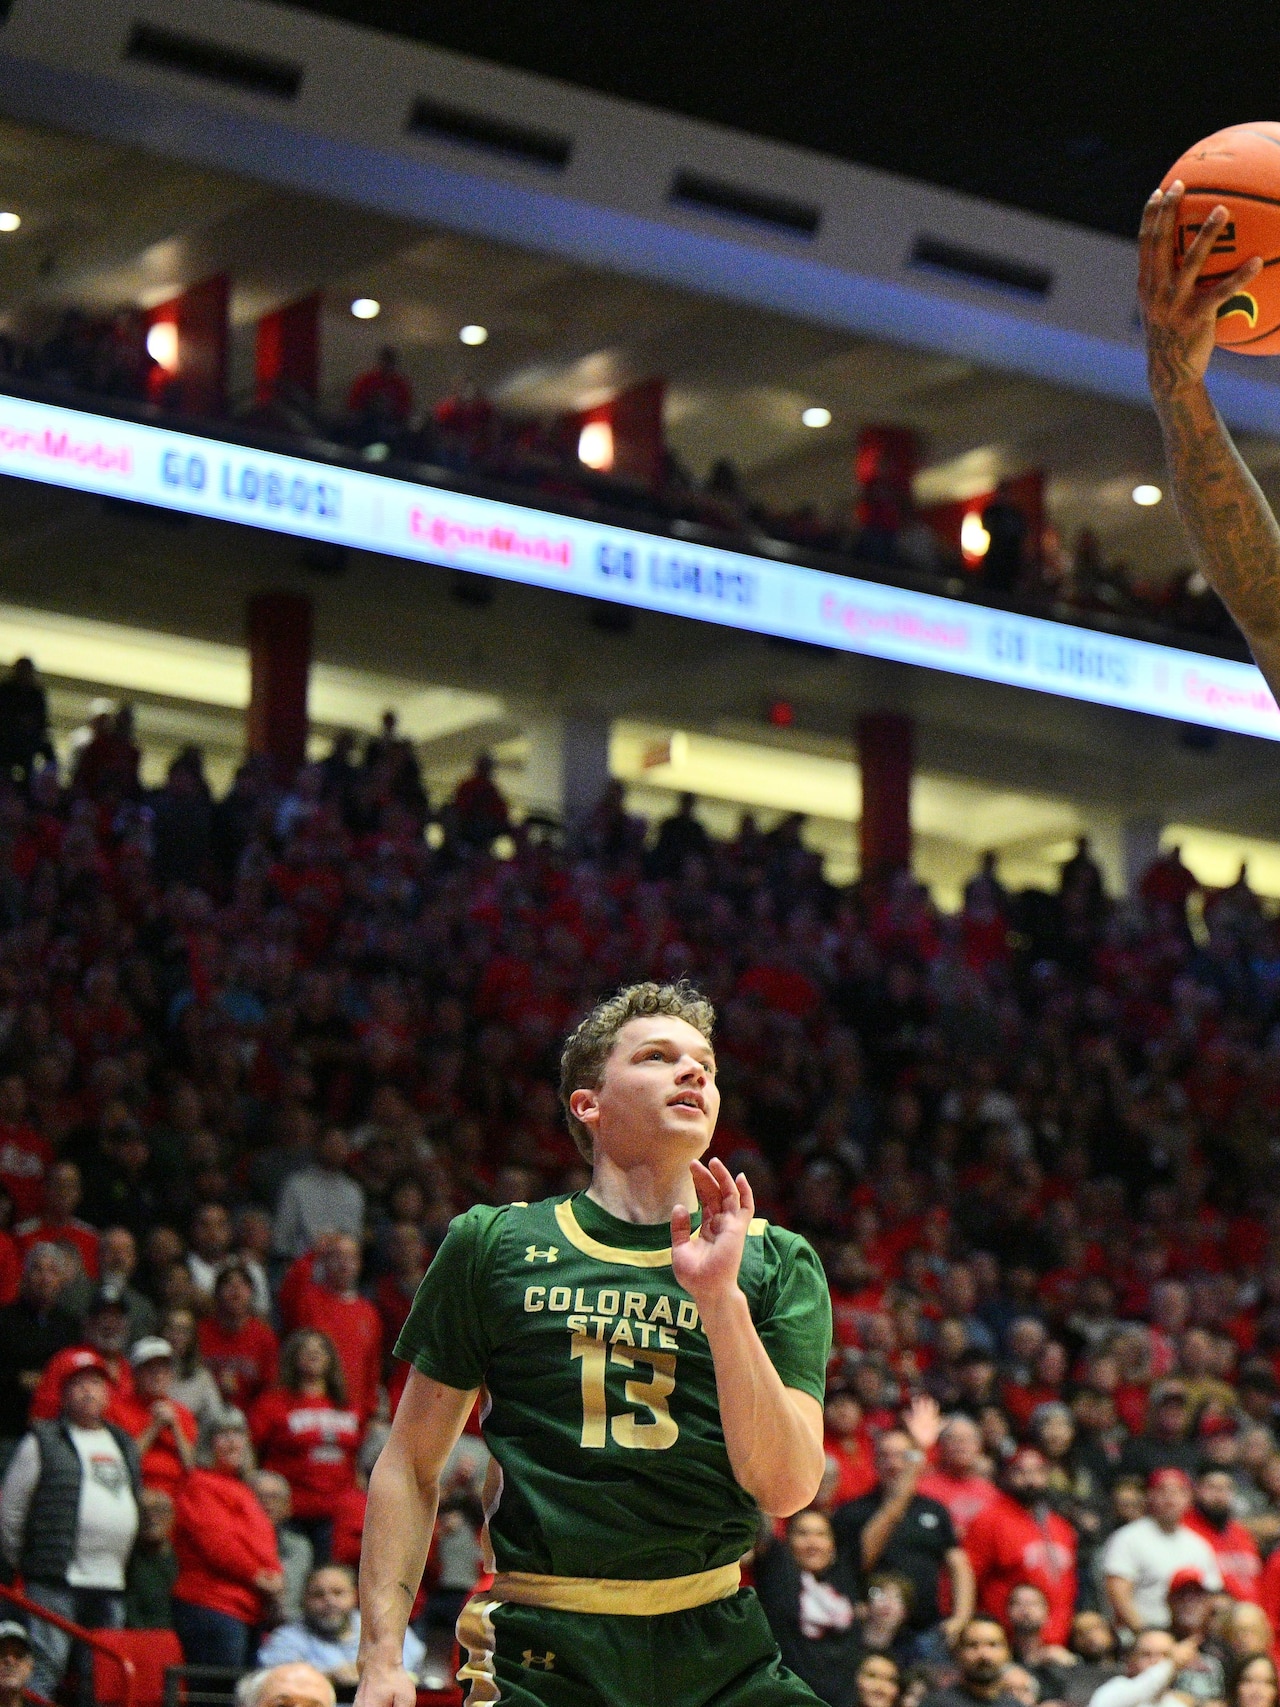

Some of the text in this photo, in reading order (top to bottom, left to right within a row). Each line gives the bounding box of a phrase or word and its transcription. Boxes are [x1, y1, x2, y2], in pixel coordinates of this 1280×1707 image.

[162, 449, 207, 490] GO
[523, 1286, 706, 1334] COLORAD
[566, 1314, 679, 1350] STATE
[570, 1334, 679, 1450] 13
